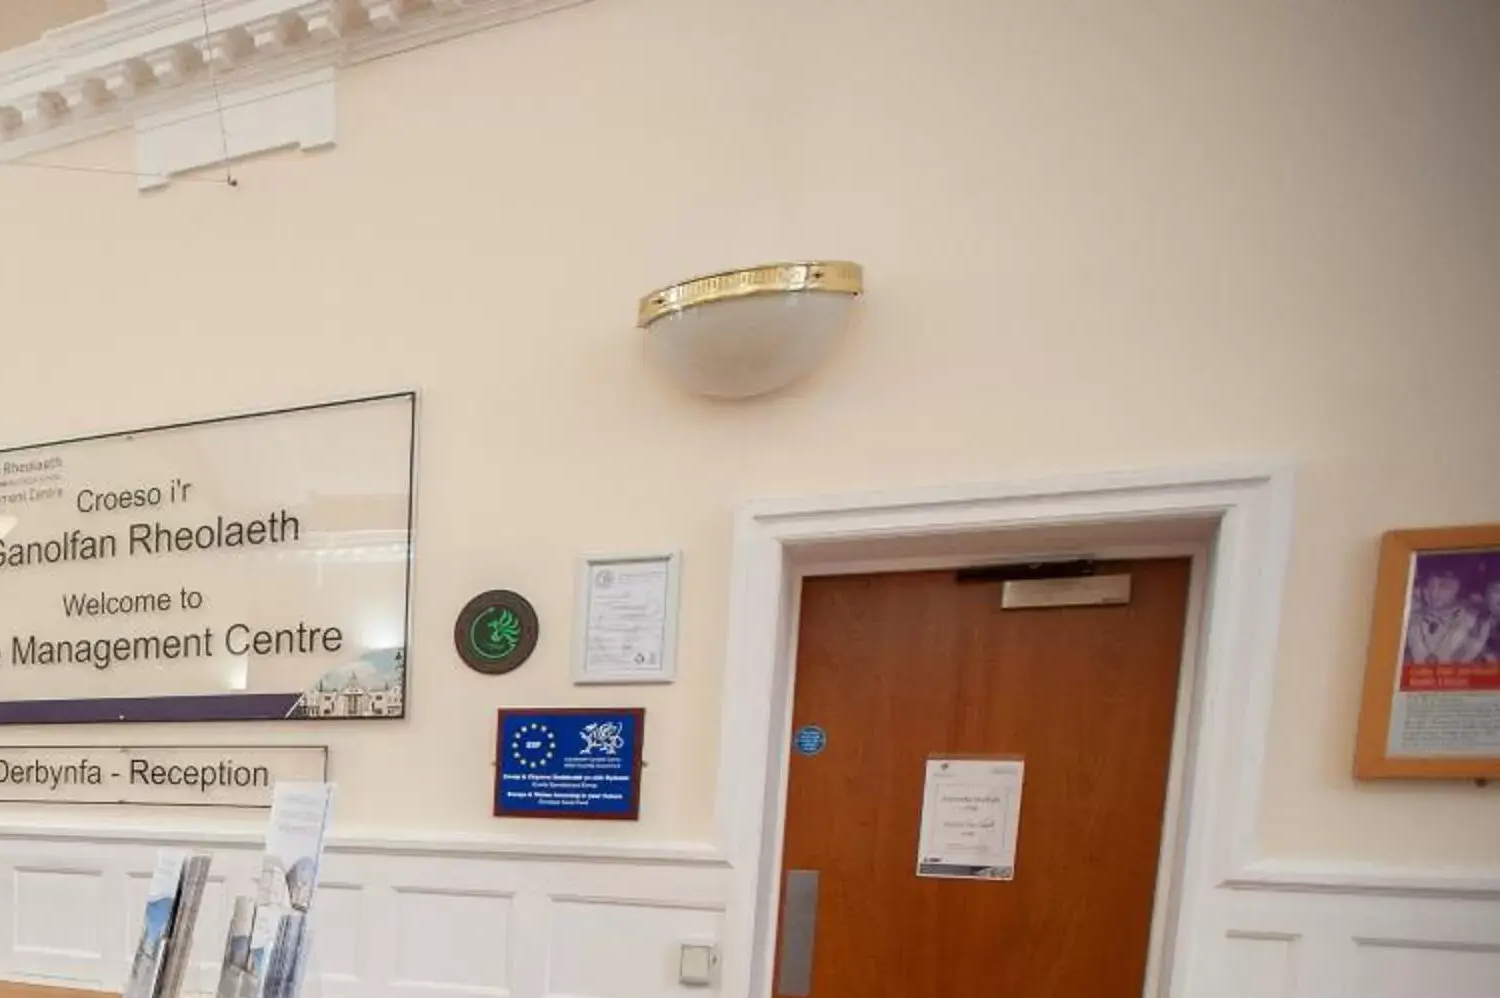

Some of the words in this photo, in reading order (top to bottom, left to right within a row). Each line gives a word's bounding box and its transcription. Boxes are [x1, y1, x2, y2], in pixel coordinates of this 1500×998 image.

[77, 487, 161, 514] Croeso
[170, 480, 192, 503] i'r
[129, 510, 299, 555] Rheolaeth
[62, 592, 171, 618] Welcome
[180, 586, 203, 609] to
[12, 627, 213, 670] Management
[224, 622, 344, 656] Centre
[129, 760, 269, 791] Reception
